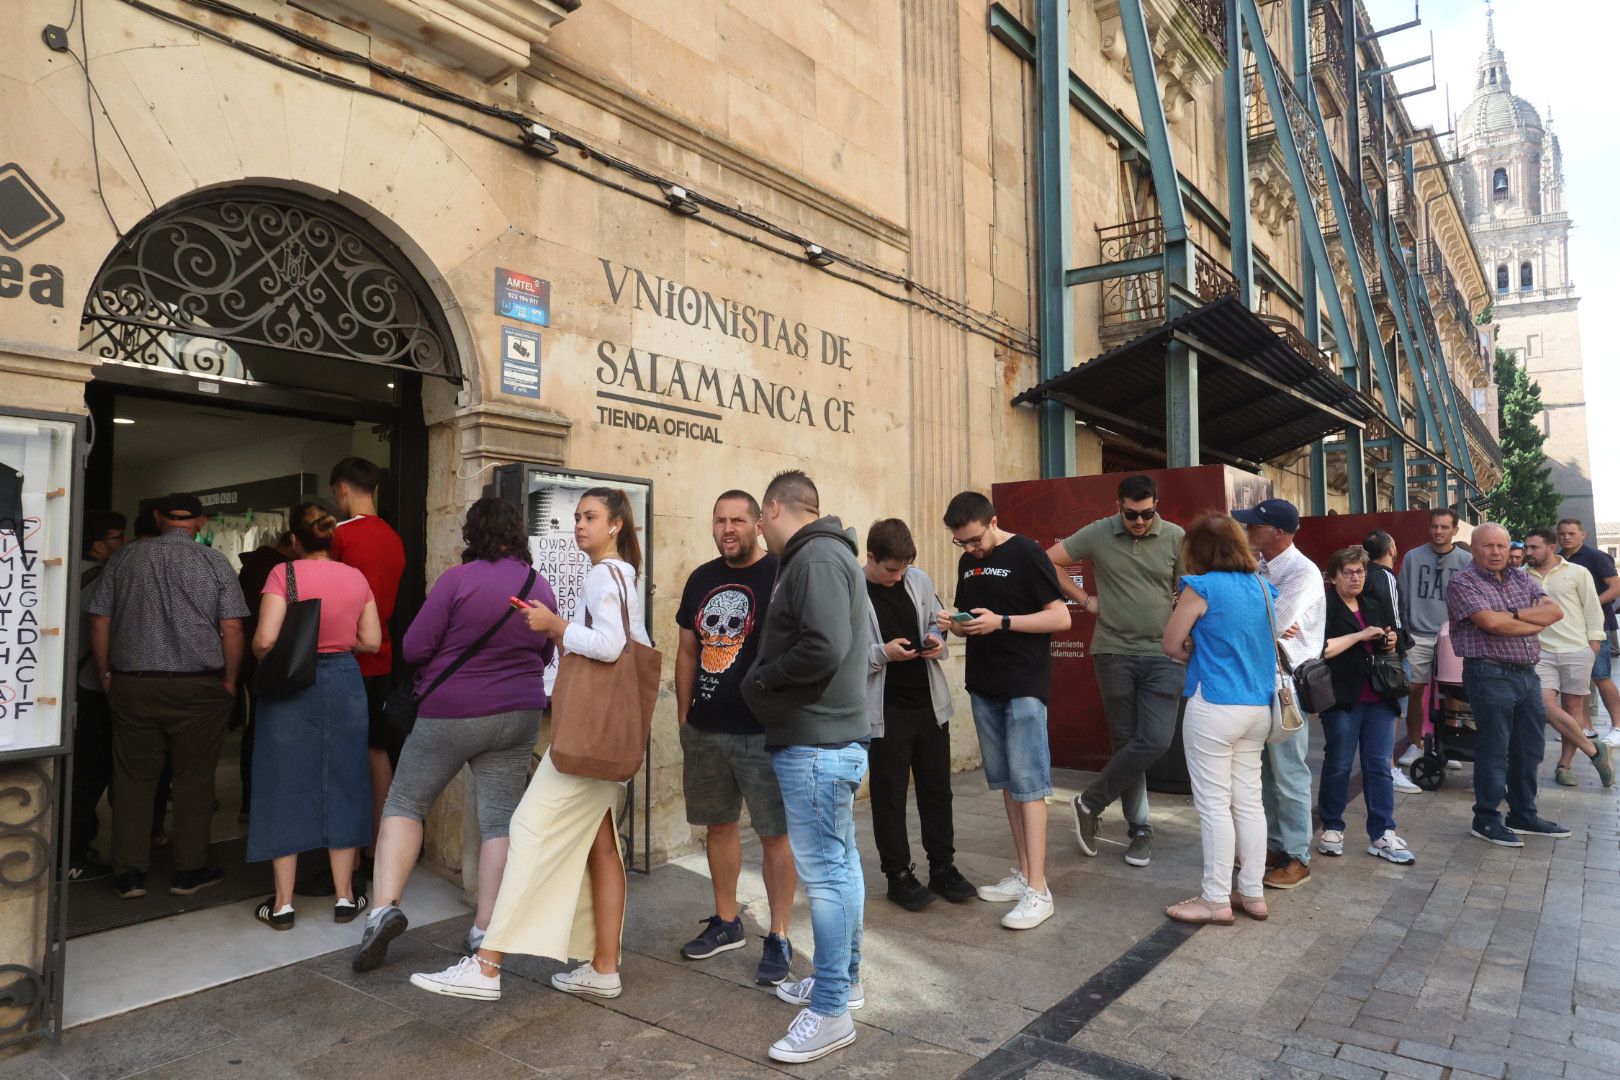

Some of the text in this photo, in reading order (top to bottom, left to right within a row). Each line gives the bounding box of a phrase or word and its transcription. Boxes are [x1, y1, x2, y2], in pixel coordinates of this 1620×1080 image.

[0, 255, 65, 308] ea
[506, 276, 536, 292] AMTEL
[821, 330, 853, 370] DE
[597, 340, 816, 427] SALAMANCA
[824, 397, 856, 434] CF
[597, 406, 723, 444] TIENDA OFICIAL
[1050, 639, 1084, 648] ntamiento
